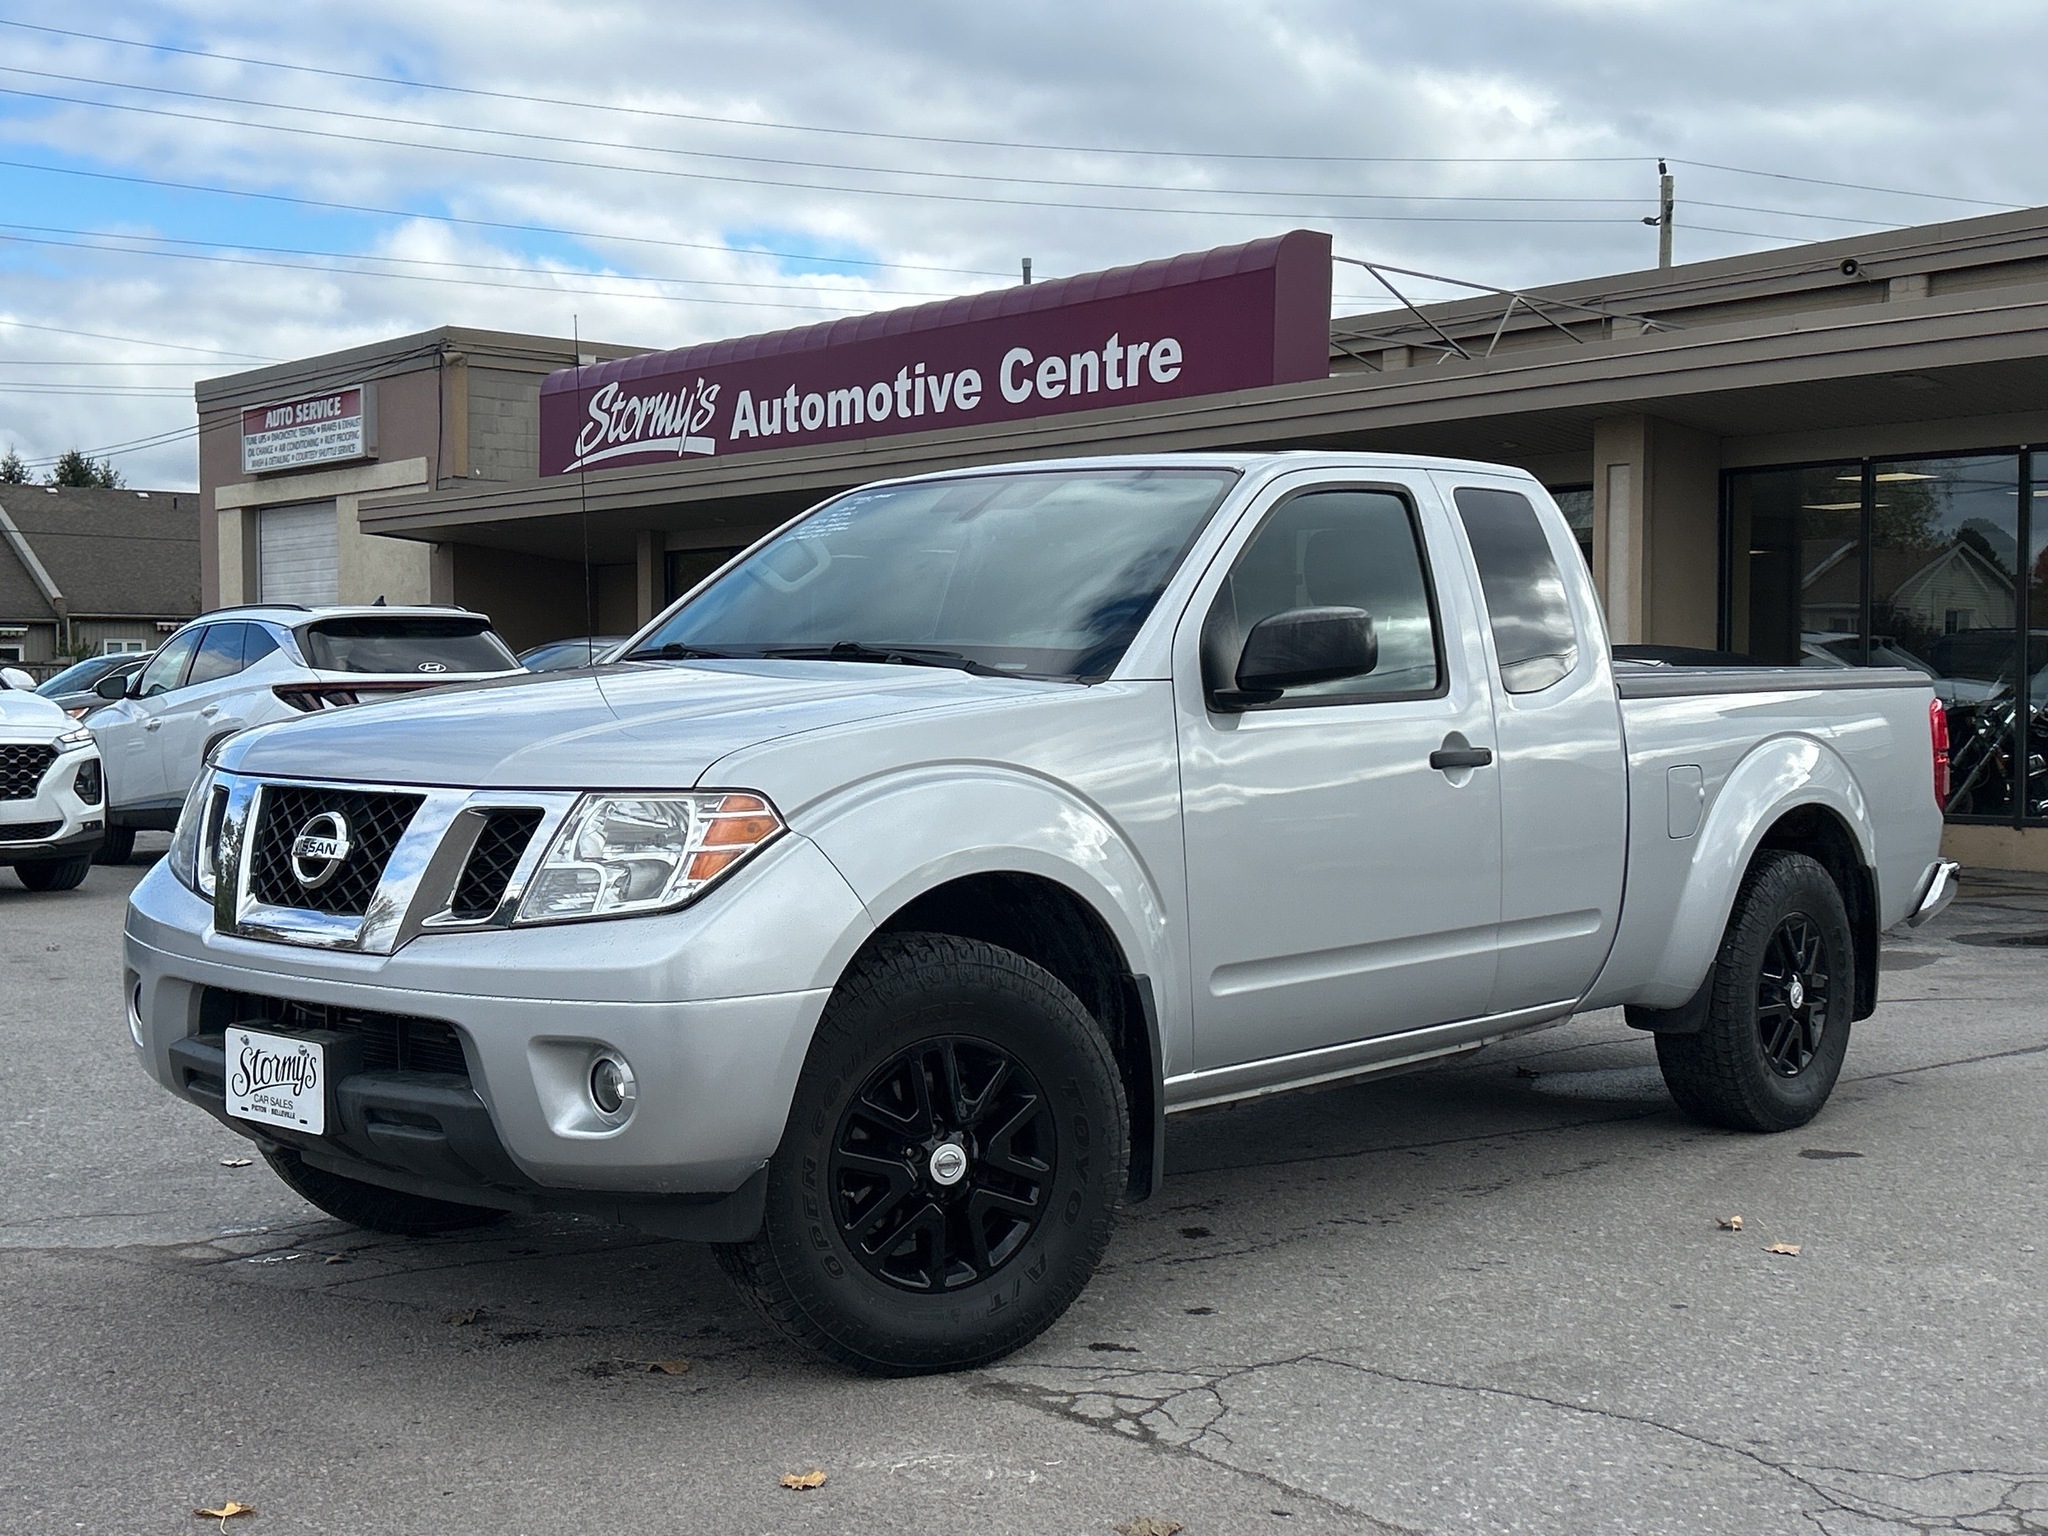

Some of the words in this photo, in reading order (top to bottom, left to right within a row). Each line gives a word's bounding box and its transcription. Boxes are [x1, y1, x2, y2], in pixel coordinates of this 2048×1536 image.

[265, 407, 293, 429] AUTO
[296, 397, 341, 423] SERVICE
[575, 378, 721, 459] Stormy's
[729, 363, 982, 440] Automotive
[999, 332, 1183, 404] Centre
[232, 1046, 317, 1097] Stormy's
[251, 1104, 267, 1113] PICTON
[254, 1094, 269, 1104] CAR
[270, 1097, 294, 1109] SALES
[1060, 1077, 1091, 1227] TOYO
[802, 1156, 846, 1279] OPEN
